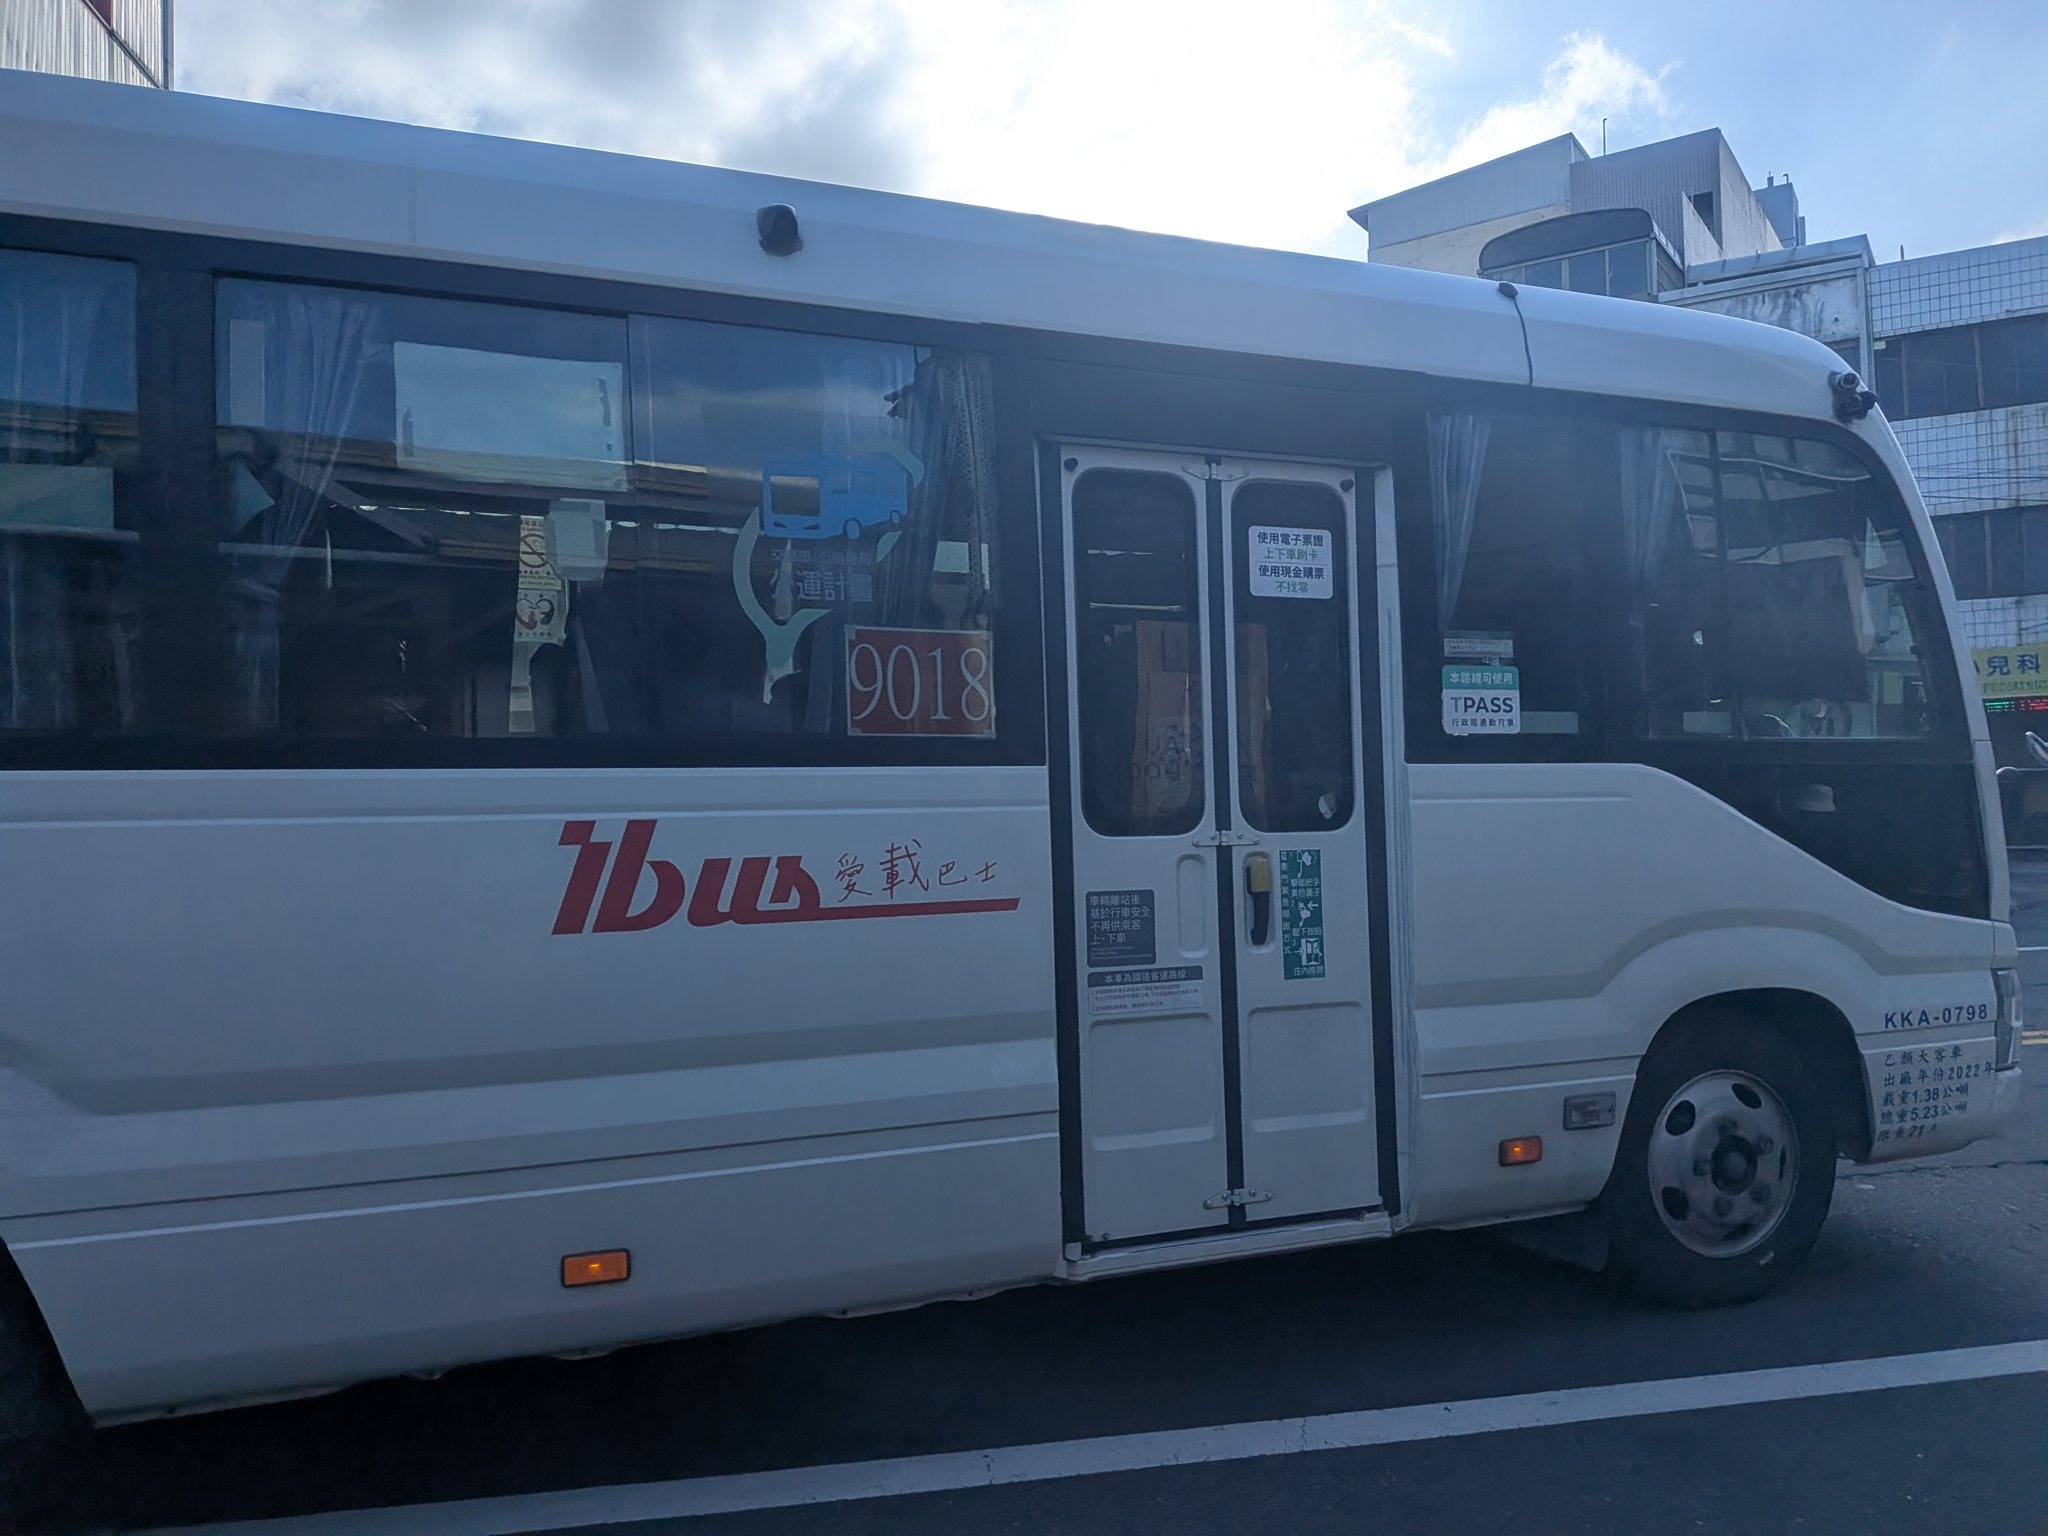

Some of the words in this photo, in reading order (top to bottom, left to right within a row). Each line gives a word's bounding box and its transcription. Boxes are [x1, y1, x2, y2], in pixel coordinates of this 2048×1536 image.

[1257, 531, 1324, 547] 使用電子票證
[1264, 547, 1319, 561] 上下車刷卡
[1258, 564, 1325, 580] 使用現金購票
[1275, 580, 1309, 593] 不找零
[1973, 653, 2041, 677] 兒科
[849, 643, 990, 721] 9018
[1450, 672, 1513, 685] 本路線可使用
[1450, 696, 1514, 713] TPASS
[833, 838, 998, 903] 愛載巴士
[1090, 906, 1152, 919] 基於行車安全
[1090, 919, 1142, 932] 不再供乘客
[1884, 1003, 1988, 1029] KKA-0798
[1884, 1045, 1963, 1067] 乙類大客車
